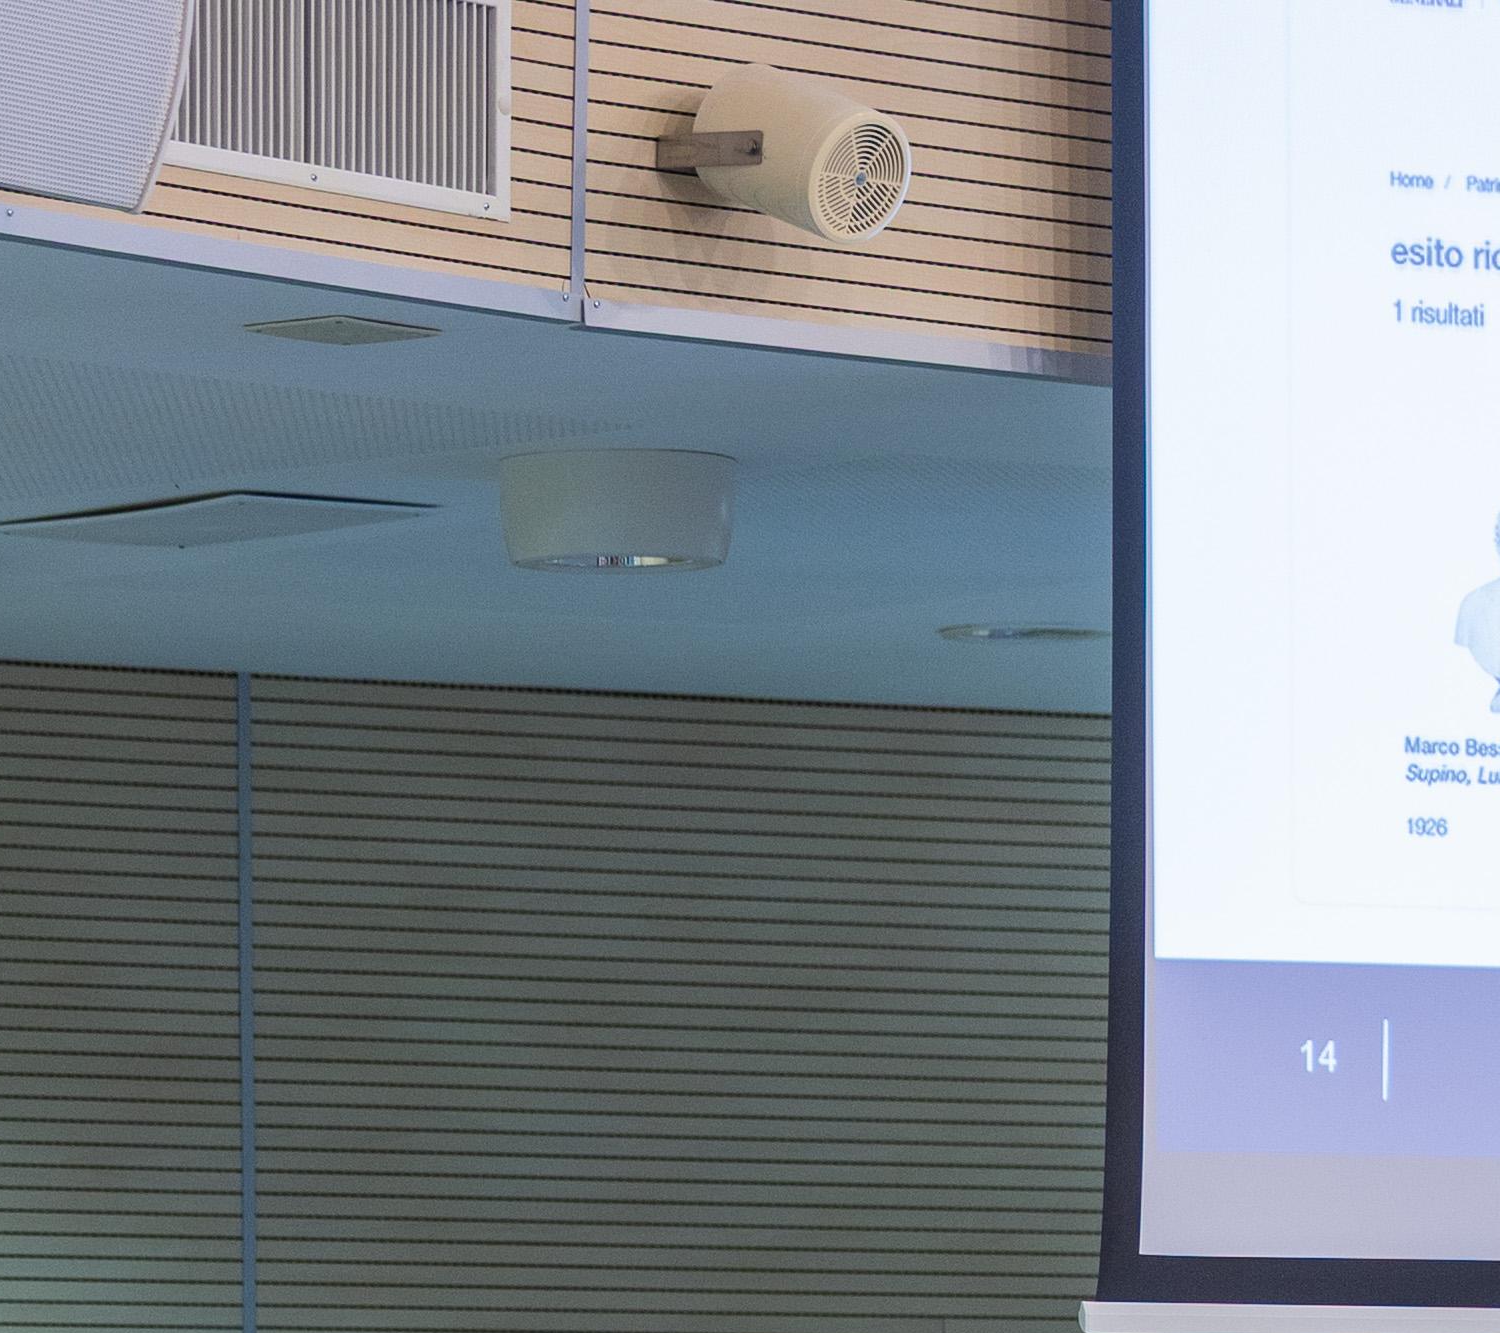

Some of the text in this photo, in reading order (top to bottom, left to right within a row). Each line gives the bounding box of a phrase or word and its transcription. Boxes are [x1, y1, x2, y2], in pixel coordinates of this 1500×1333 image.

[1390, 171, 1434, 190] Home
[1391, 237, 1463, 269] esito
[1393, 300, 1485, 328] 1 risultati
[1404, 735, 1460, 756] Marco
[1406, 764, 1471, 786] Supino,
[1407, 817, 1448, 837] 1926
[1299, 1039, 1338, 1073] 14
